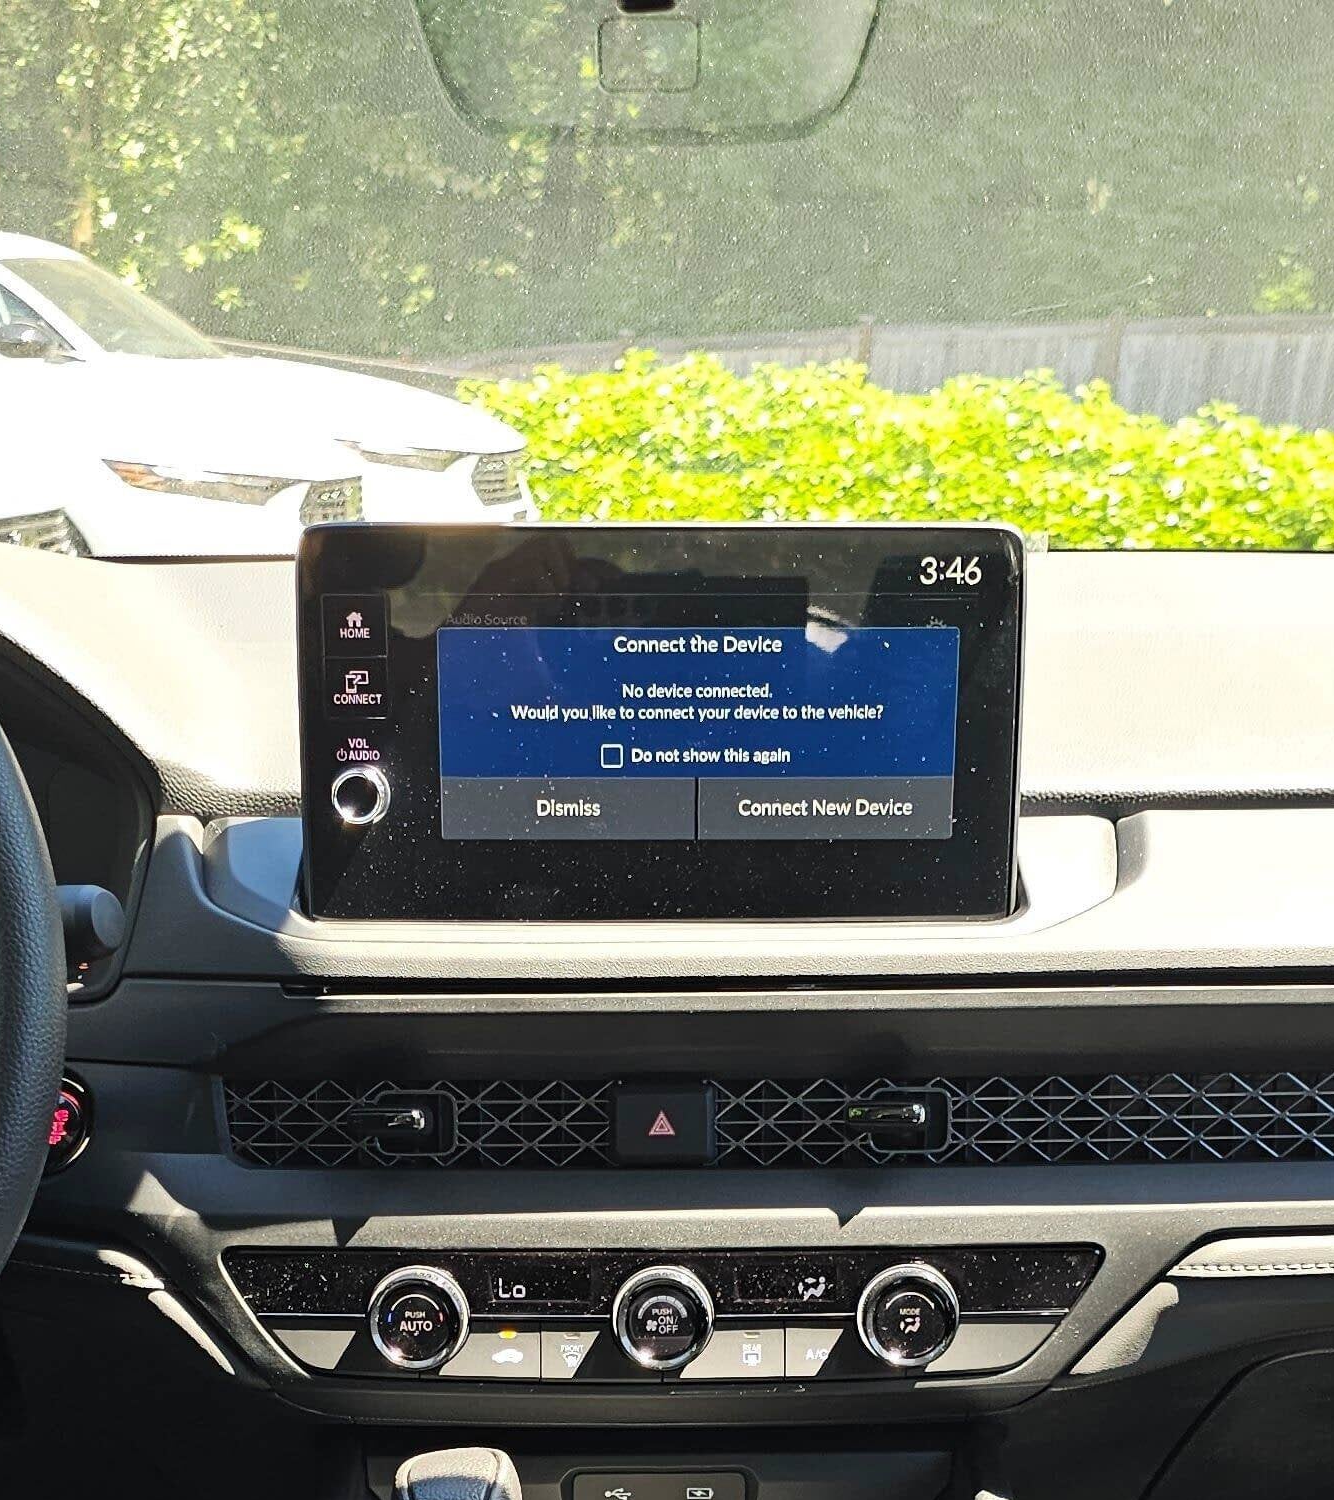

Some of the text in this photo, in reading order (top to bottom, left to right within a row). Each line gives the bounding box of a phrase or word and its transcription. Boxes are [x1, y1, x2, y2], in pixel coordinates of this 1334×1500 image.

[919, 555, 983, 586] 3:46
[339, 628, 371, 639] HOME
[613, 634, 783, 653] Connect the Device
[622, 683, 773, 698] No device connected.
[333, 693, 383, 705] CONNECT
[511, 704, 884, 723] Would you like to connect your device to the vehicle?
[348, 738, 370, 748] VOL
[349, 750, 380, 761] AUDIO
[631, 748, 791, 765] Do not show this again
[536, 799, 601, 817] Dismiss
[738, 799, 913, 817] Connect New Device
[498, 1278, 526, 1298] Lo
[404, 1311, 426, 1319] PUSH
[651, 1308, 673, 1316] PUSH
[899, 1308, 921, 1316] MODE
[399, 1320, 433, 1332] AUTO
[657, 1315, 679, 1327] ON/
[658, 1325, 679, 1334] OFF
[805, 1348, 829, 1360] A/C
